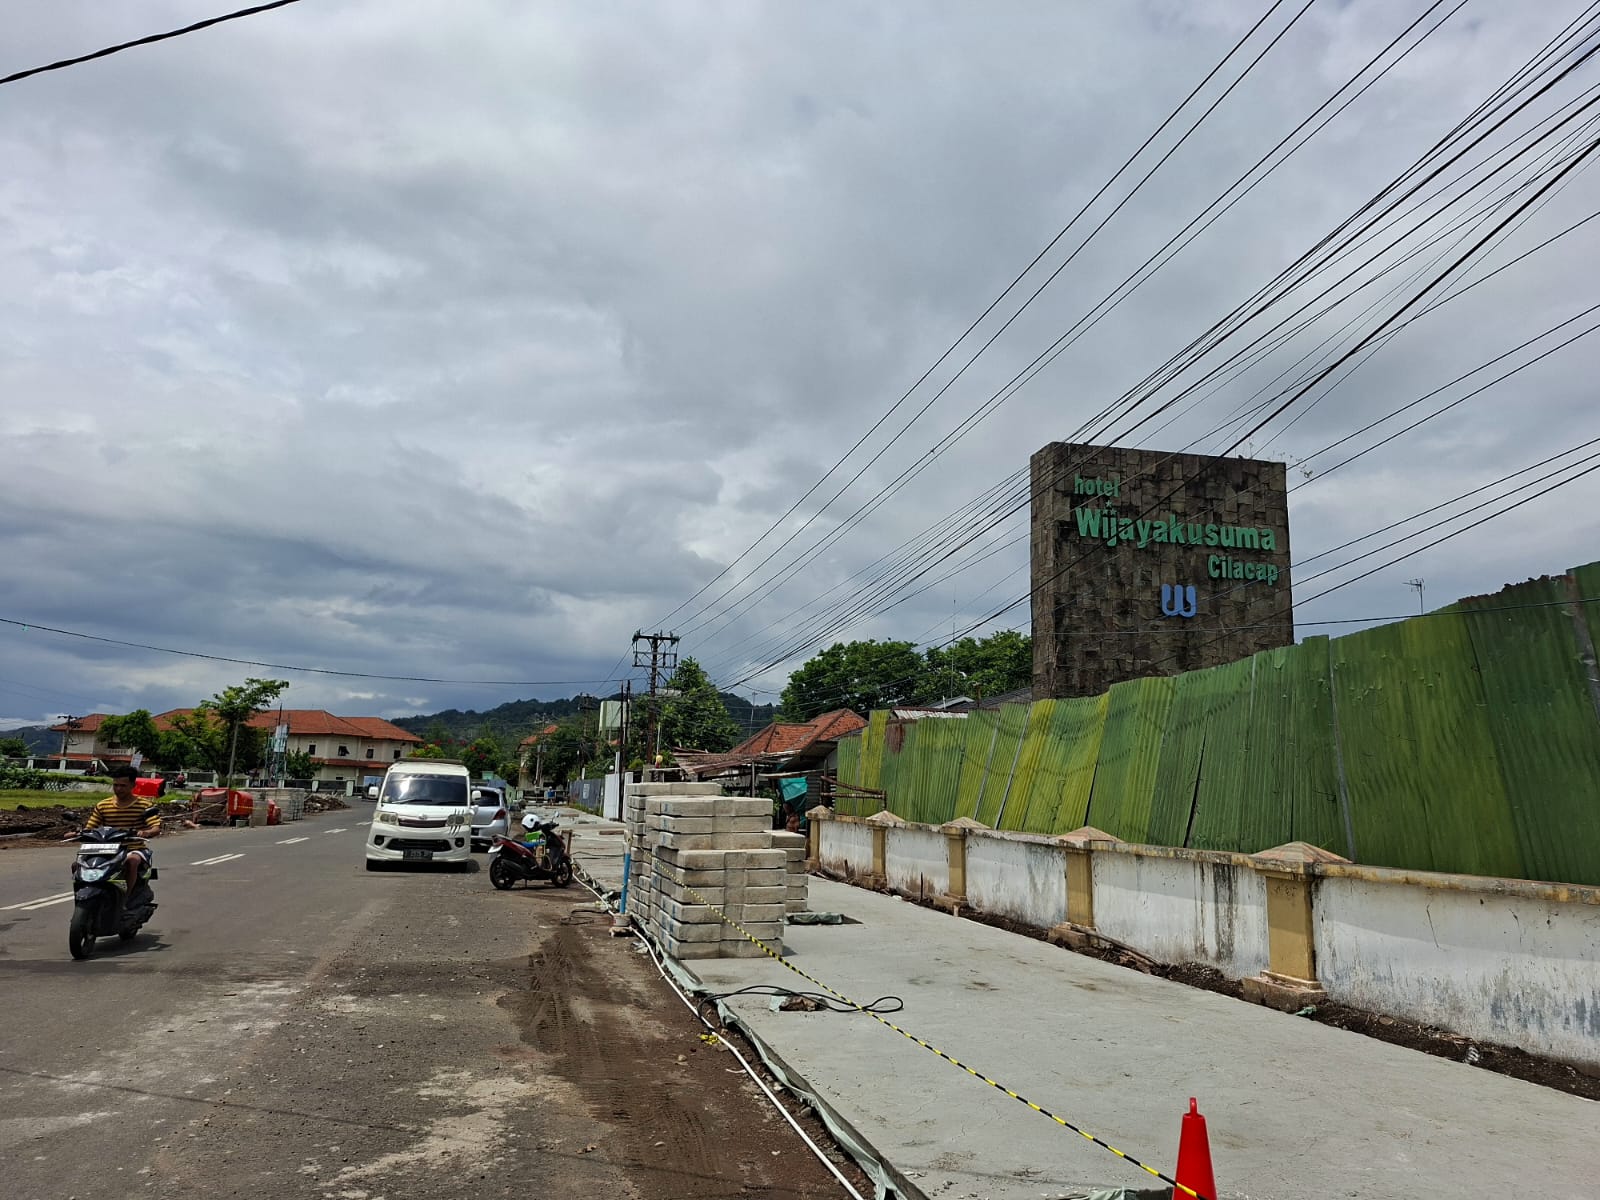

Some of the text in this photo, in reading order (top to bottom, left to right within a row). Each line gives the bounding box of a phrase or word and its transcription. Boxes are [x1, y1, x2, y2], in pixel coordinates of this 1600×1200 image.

[1074, 474, 1120, 497] hotel
[1075, 507, 1276, 549] Wijayakusuma
[1207, 554, 1279, 585] Cilacap
